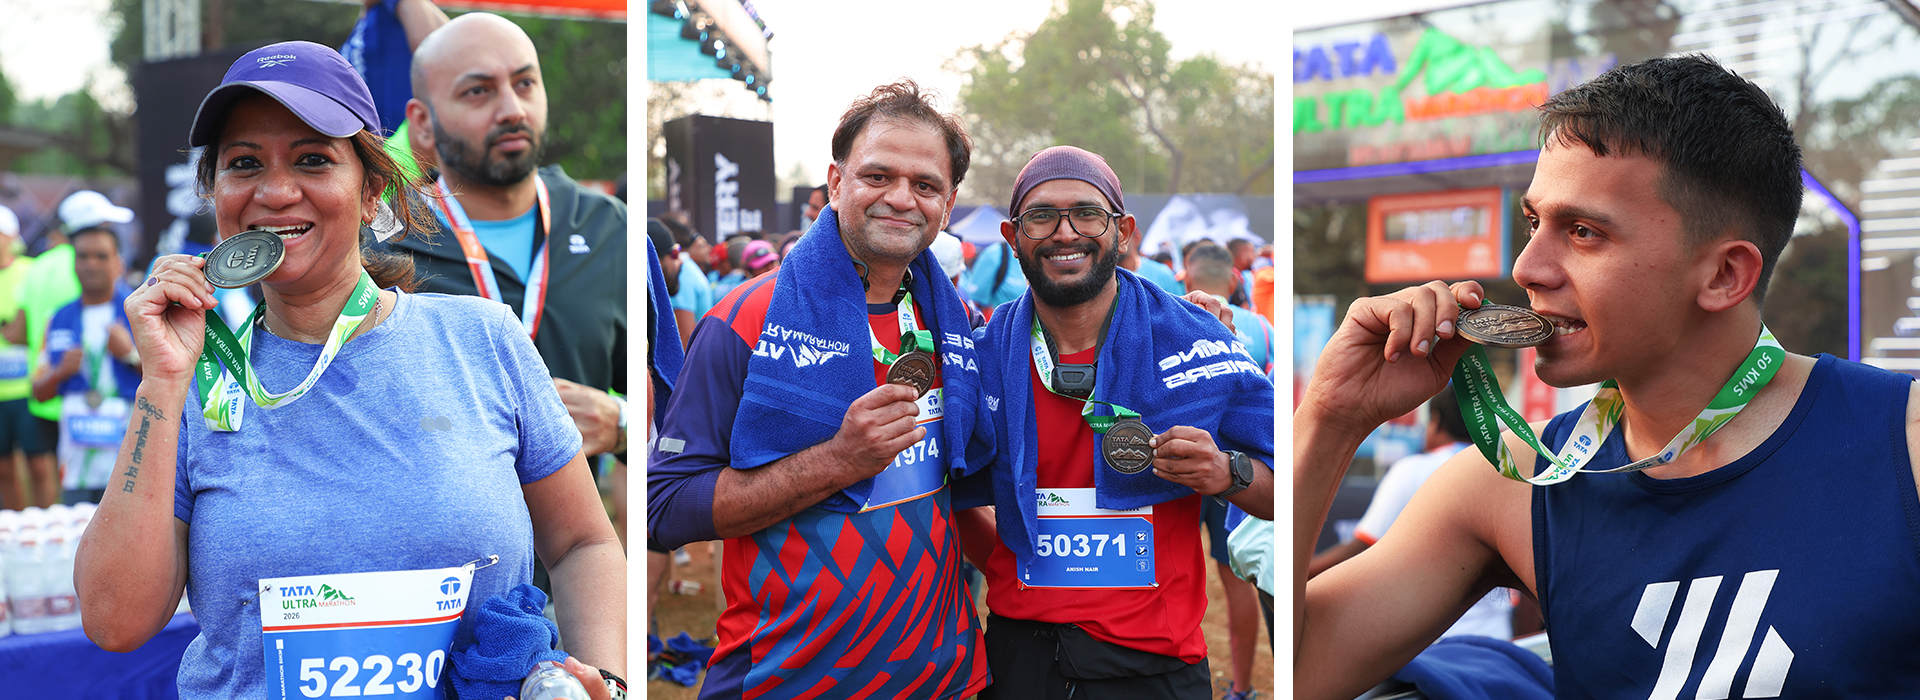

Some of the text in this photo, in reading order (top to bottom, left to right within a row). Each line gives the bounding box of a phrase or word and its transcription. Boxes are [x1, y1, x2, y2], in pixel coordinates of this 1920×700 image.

[740, 208, 762, 232] E
[243, 245, 260, 270] TATA
[358, 285, 374, 309] KMS
[215, 337, 234, 360] ULTRA
[203, 362, 213, 380] TATA
[230, 357, 243, 376] TATA
[1733, 352, 1772, 397] 50 KMS
[1469, 354, 1534, 442] TATA ULTRA MARATHON
[1472, 395, 1485, 423] ULTRA
[1479, 423, 1493, 446] TATA
[884, 437, 939, 471] 1974
[1573, 441, 1588, 454] TATA
[1036, 492, 1046, 500] TA
[1036, 533, 1126, 557] 50371
[279, 585, 314, 598] TATA
[282, 598, 356, 610] ULTRA MARATHON
[436, 598, 462, 611] TATA
[283, 612, 300, 620] 2026
[299, 649, 446, 698] 52230
